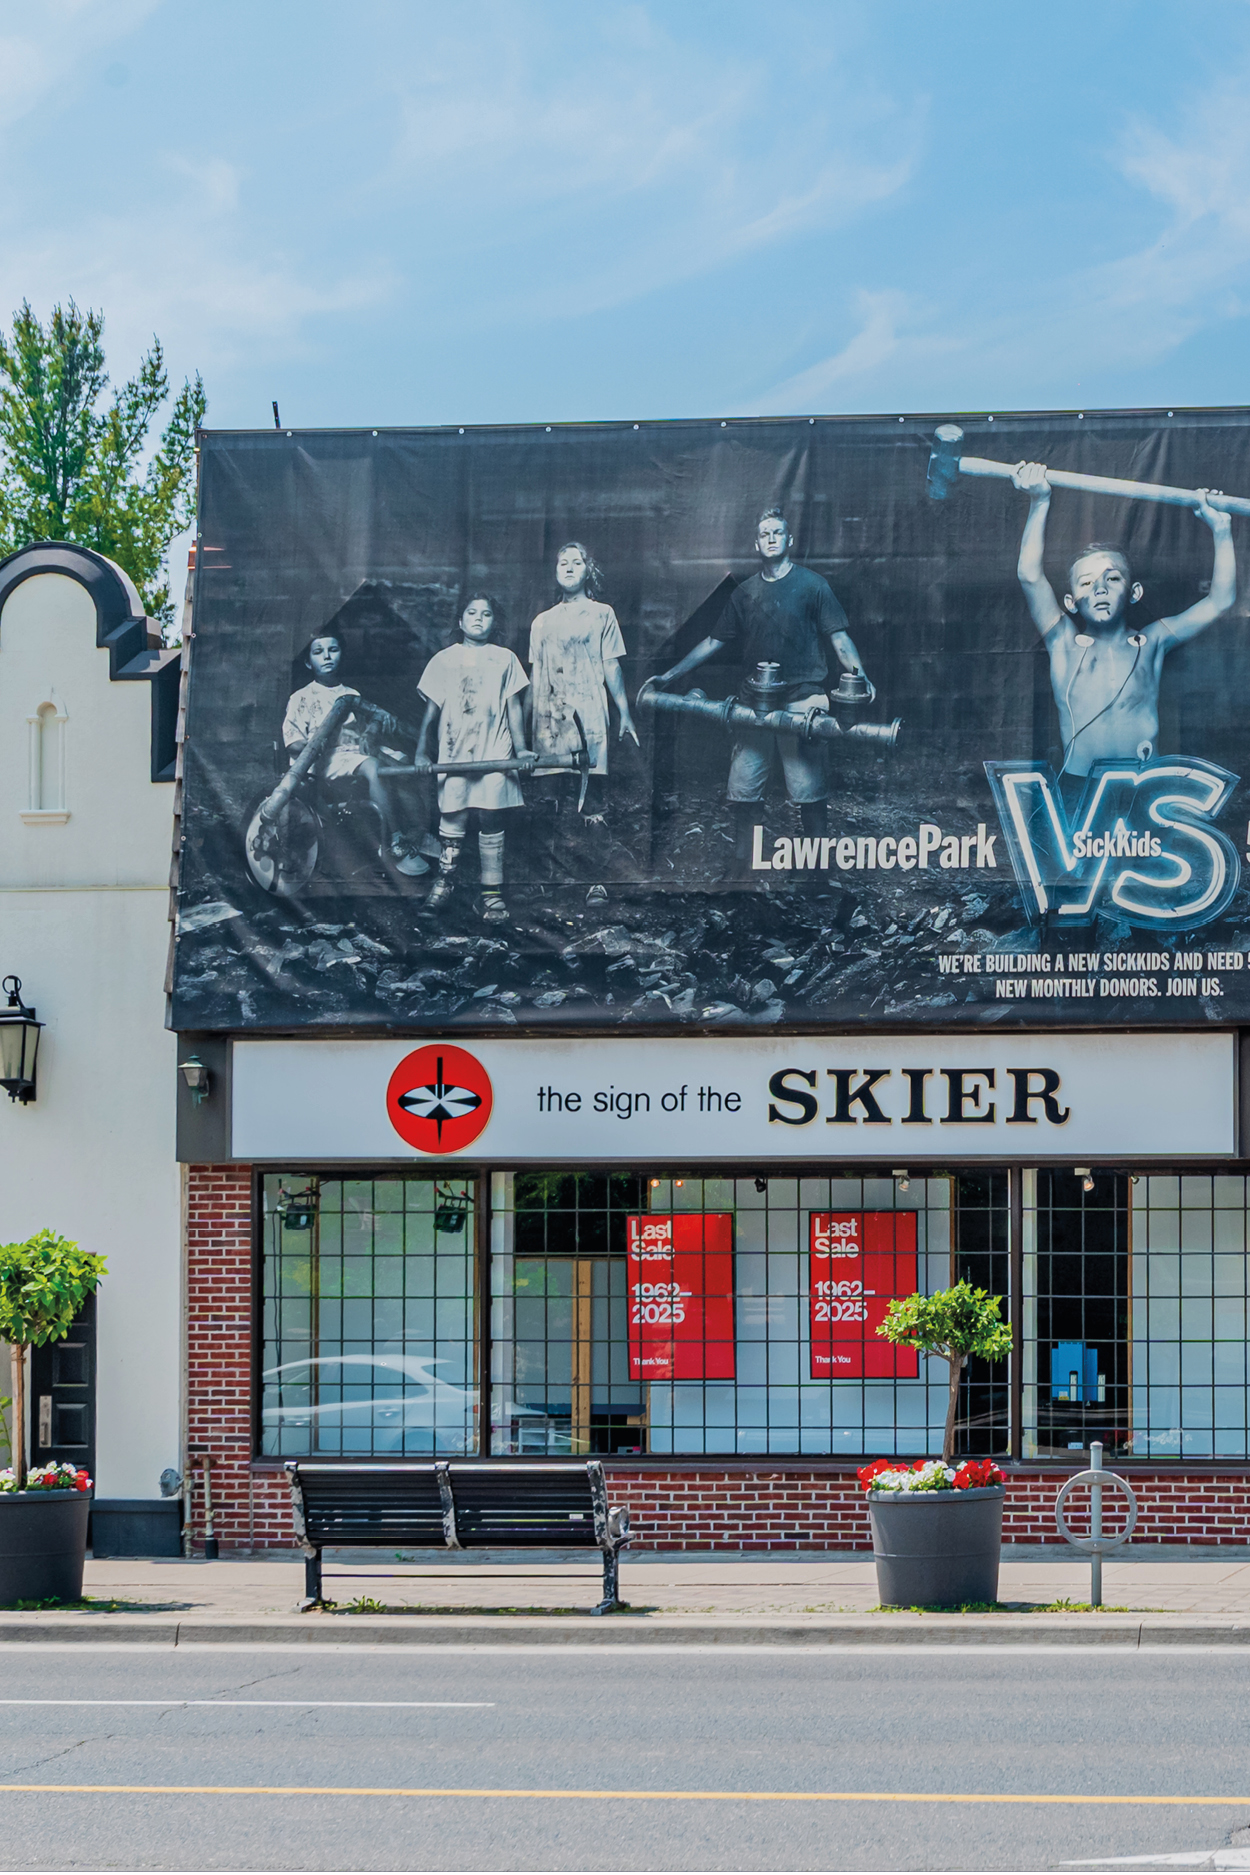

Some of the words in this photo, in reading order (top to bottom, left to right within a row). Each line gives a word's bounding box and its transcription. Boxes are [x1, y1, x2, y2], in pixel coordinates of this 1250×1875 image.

[983, 755, 1241, 931] VS
[1072, 819, 1162, 859] SickKids
[985, 954, 1051, 973] BUILDING
[1054, 954, 1065, 972] A
[1068, 953, 1100, 972] NEW
[1103, 953, 1169, 971] SICKKIDS
[1174, 952, 1203, 971] AND
[1207, 952, 1243, 970] NEED
[996, 980, 1028, 998] NEW
[1031, 979, 1096, 998] MONTHLY
[1100, 979, 1162, 997] DONORS.
[1166, 978, 1198, 997] JOIN
[1201, 978, 1224, 996] US.
[537, 1086, 582, 1112] the
[593, 1085, 650, 1119] sign
[661, 1084, 688, 1112] of
[697, 1086, 742, 1112] the
[768, 1068, 1071, 1126] SKIER
[631, 1220, 673, 1240] Last
[815, 1218, 858, 1237] Last
[815, 1238, 859, 1258] Sale
[632, 1303, 685, 1324] 2025
[814, 1302, 868, 1322] 2025
[655, 1357, 669, 1365] You
[815, 1355, 837, 1363] Thank
[837, 1355, 851, 1363] You
